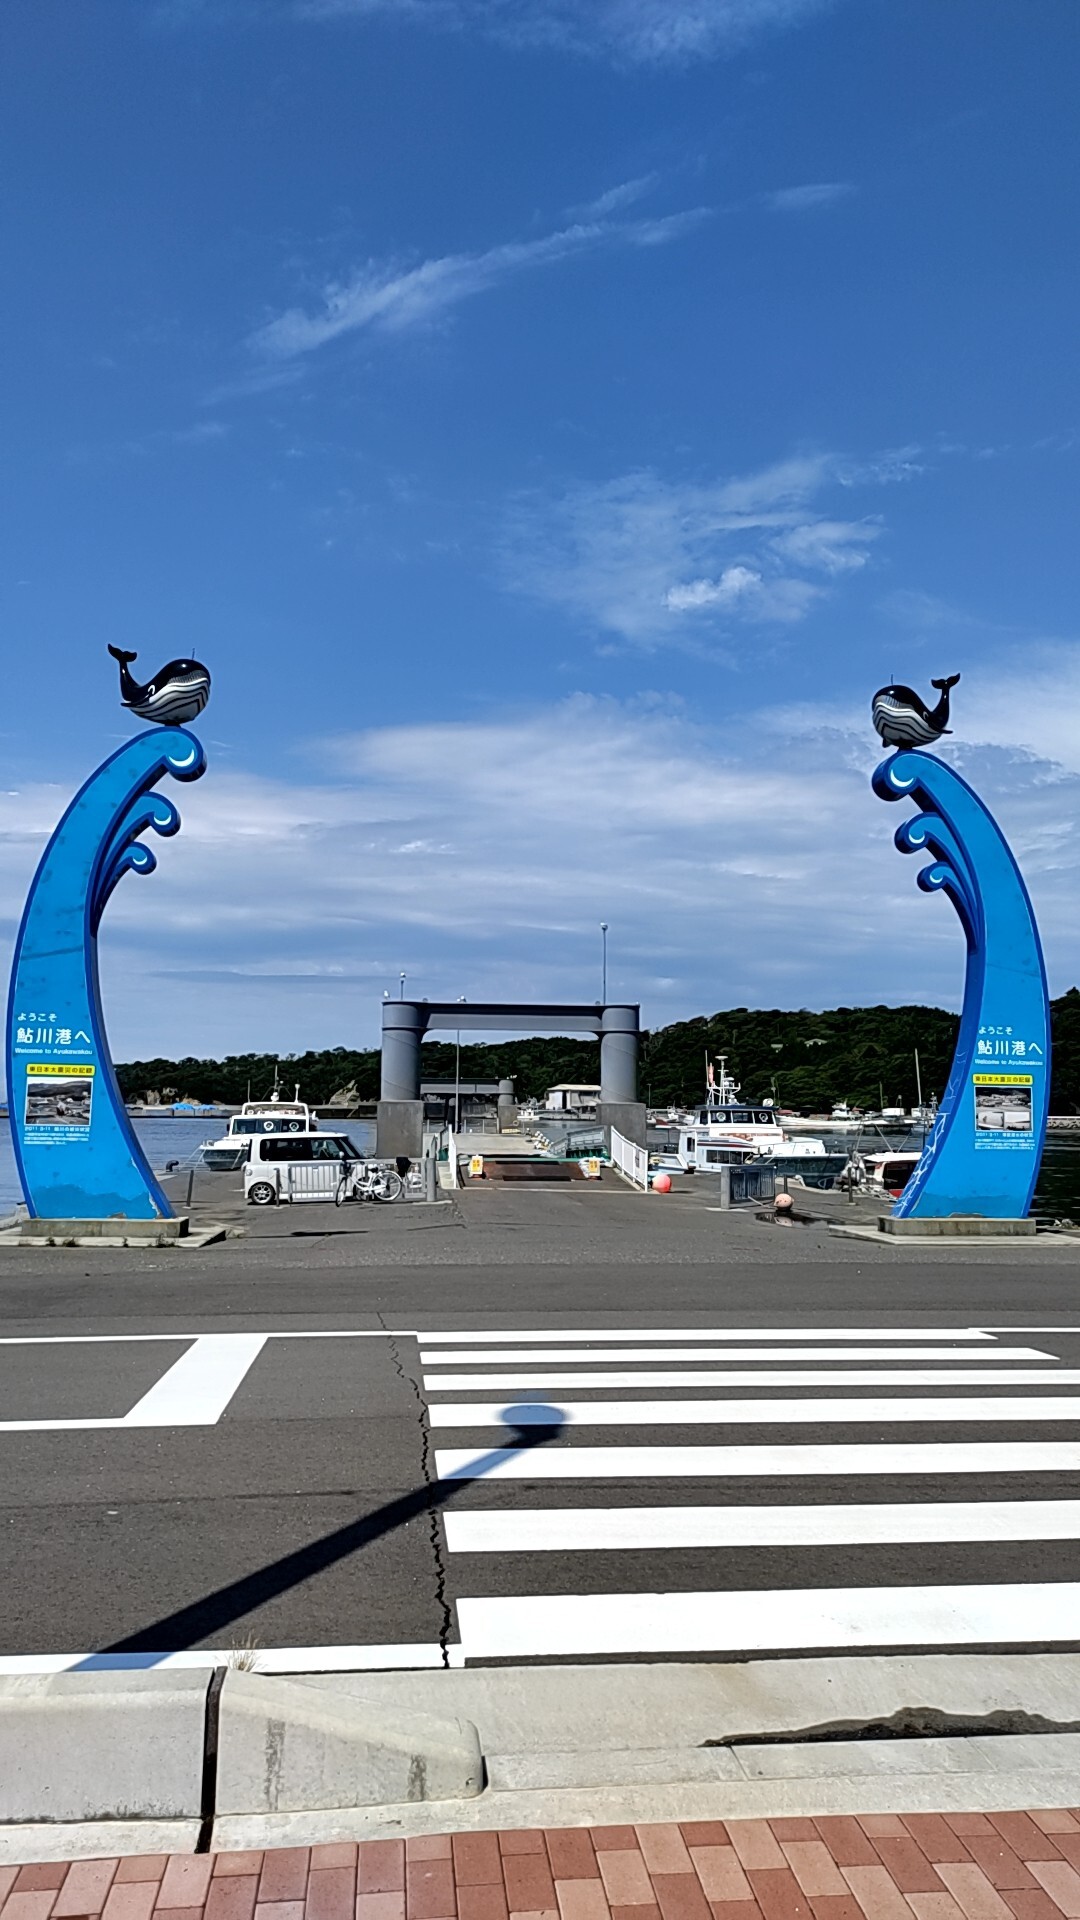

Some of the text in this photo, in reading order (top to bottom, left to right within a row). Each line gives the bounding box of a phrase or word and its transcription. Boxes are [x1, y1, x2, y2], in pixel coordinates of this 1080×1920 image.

[17, 1012, 57, 1022] ようこそ
[16, 1027, 91, 1045] 鮎川港へ
[978, 1027, 1013, 1036] ようこそ
[977, 1040, 1043, 1056] 鮎川港へ
[29, 1066, 93, 1074] 東日本大震災の記録
